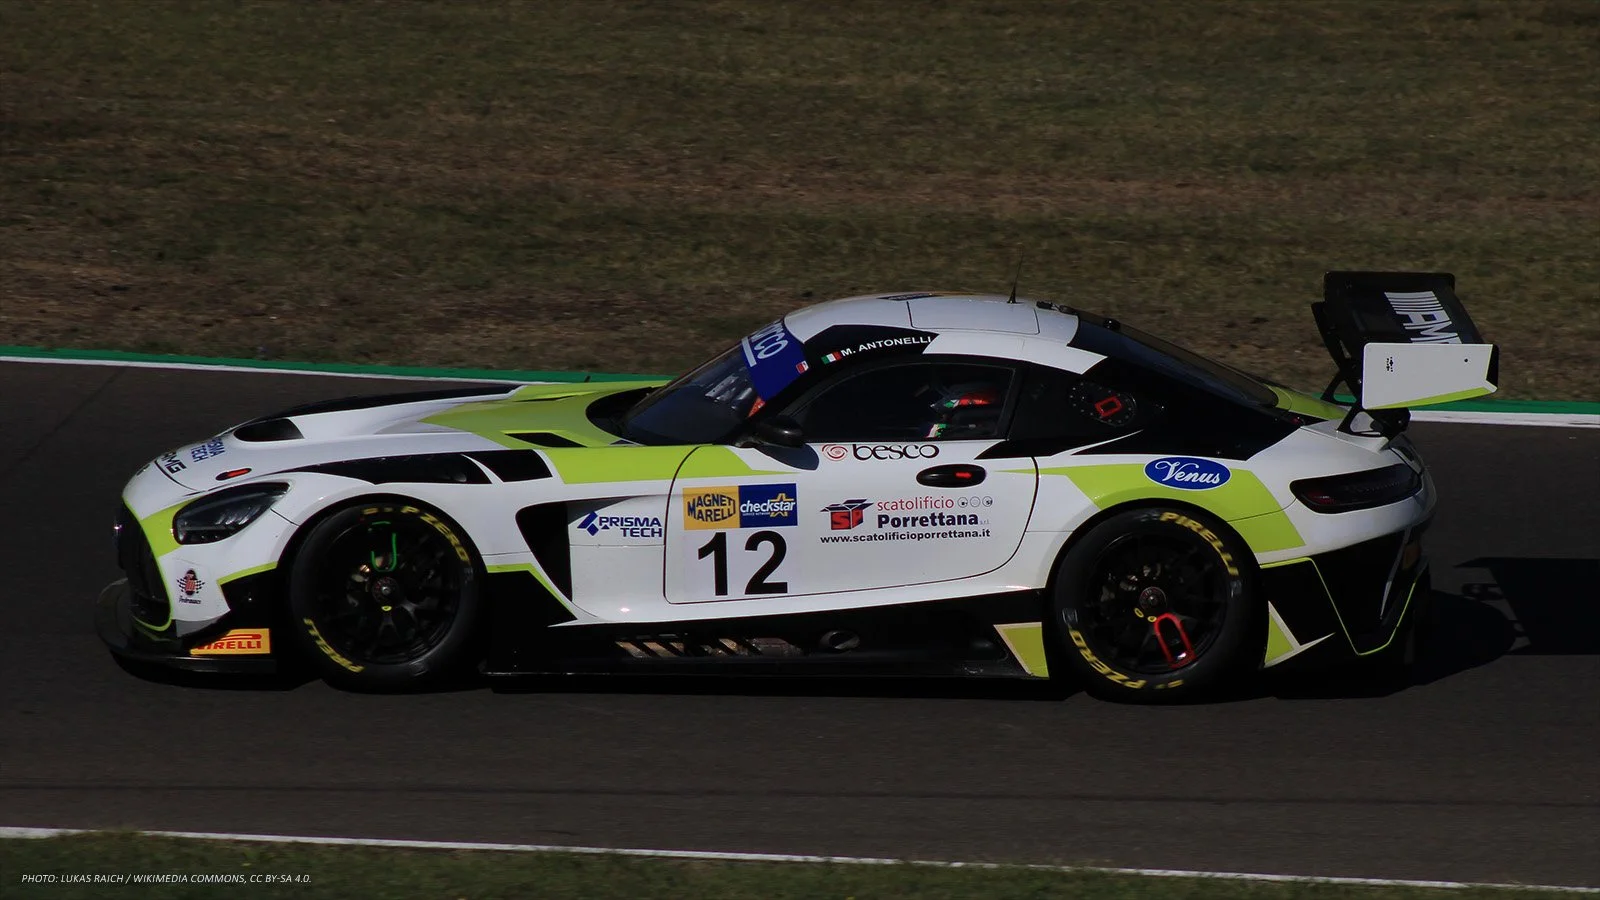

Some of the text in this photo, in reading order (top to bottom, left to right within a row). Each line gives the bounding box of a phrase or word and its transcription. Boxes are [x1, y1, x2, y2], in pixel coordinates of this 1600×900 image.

[1396, 311, 1462, 344] AM
[750, 317, 788, 360] arco
[840, 335, 931, 357] M. ANTONELLI
[853, 444, 940, 460] besco
[1155, 460, 1221, 484] Venus
[687, 493, 736, 512] MAGNETI
[740, 498, 796, 513] checkstar
[877, 496, 954, 511] scatolificio
[599, 516, 662, 527] PRISMA
[687, 506, 736, 522] MARELLI
[877, 512, 979, 528] Porrettana
[620, 527, 663, 538] TECH
[820, 529, 991, 543] www.scatolificioporrettana.it
[1160, 511, 1239, 576] PIRELLI
[698, 530, 788, 596] 12
[197, 641, 262, 650] IRELLI
